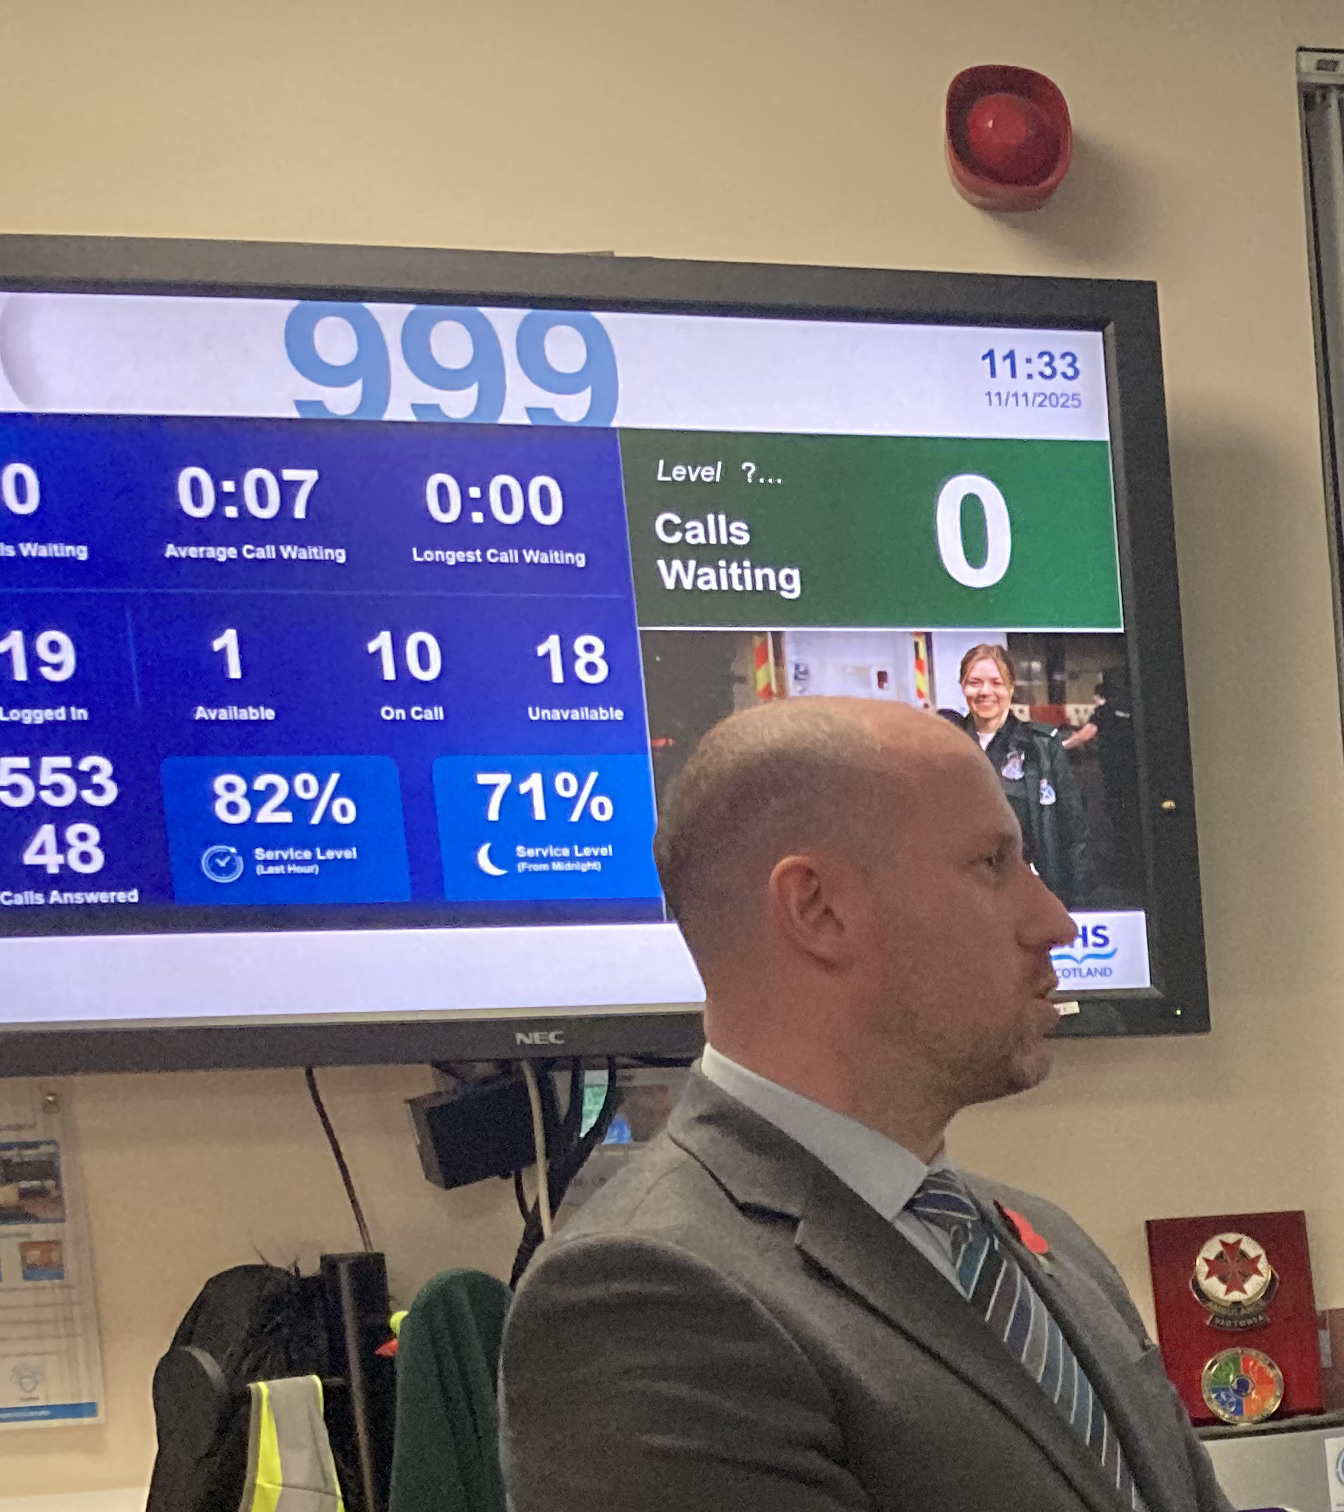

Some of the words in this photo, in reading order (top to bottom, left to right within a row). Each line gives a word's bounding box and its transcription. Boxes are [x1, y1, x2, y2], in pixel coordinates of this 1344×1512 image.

[284, 300, 619, 428] 999
[981, 348, 1080, 381] 11:33
[985, 390, 1082, 409] 11/11/2025
[657, 459, 722, 483] Level
[177, 466, 319, 519] 0:07
[425, 473, 564, 526] 0:00
[655, 512, 750, 545] Calls
[936, 474, 1012, 588] 0
[19, 543, 88, 561] Waiting
[165, 543, 238, 562] Average
[242, 545, 276, 559] Call
[279, 545, 347, 564] Waiting
[412, 548, 482, 566] Longest
[486, 549, 519, 563] Call
[522, 549, 586, 568] Waiting
[656, 558, 801, 600] Waiting
[212, 629, 243, 680] 1
[367, 631, 442, 681] 10
[536, 635, 609, 684] 18
[0, 706, 66, 725] Logged
[70, 706, 88, 720] In
[195, 706, 276, 721] Available
[381, 706, 406, 720] On
[410, 706, 445, 721] Call
[527, 706, 625, 721] Unavailable
[213, 772, 357, 825] 82%
[476, 771, 614, 822] 71%
[23, 823, 105, 874] 48
[254, 847, 312, 861] Service
[316, 847, 358, 860] Level
[515, 845, 570, 857] Service
[574, 844, 613, 857] Level
[256, 864, 285, 876] (Last
[287, 864, 319, 875] Hour)
[517, 862, 549, 873] (From
[551, 861, 602, 873] Midnight)
[0, 890, 45, 906] Calls
[49, 888, 139, 905] Answered
[514, 1030, 565, 1045] NEC
